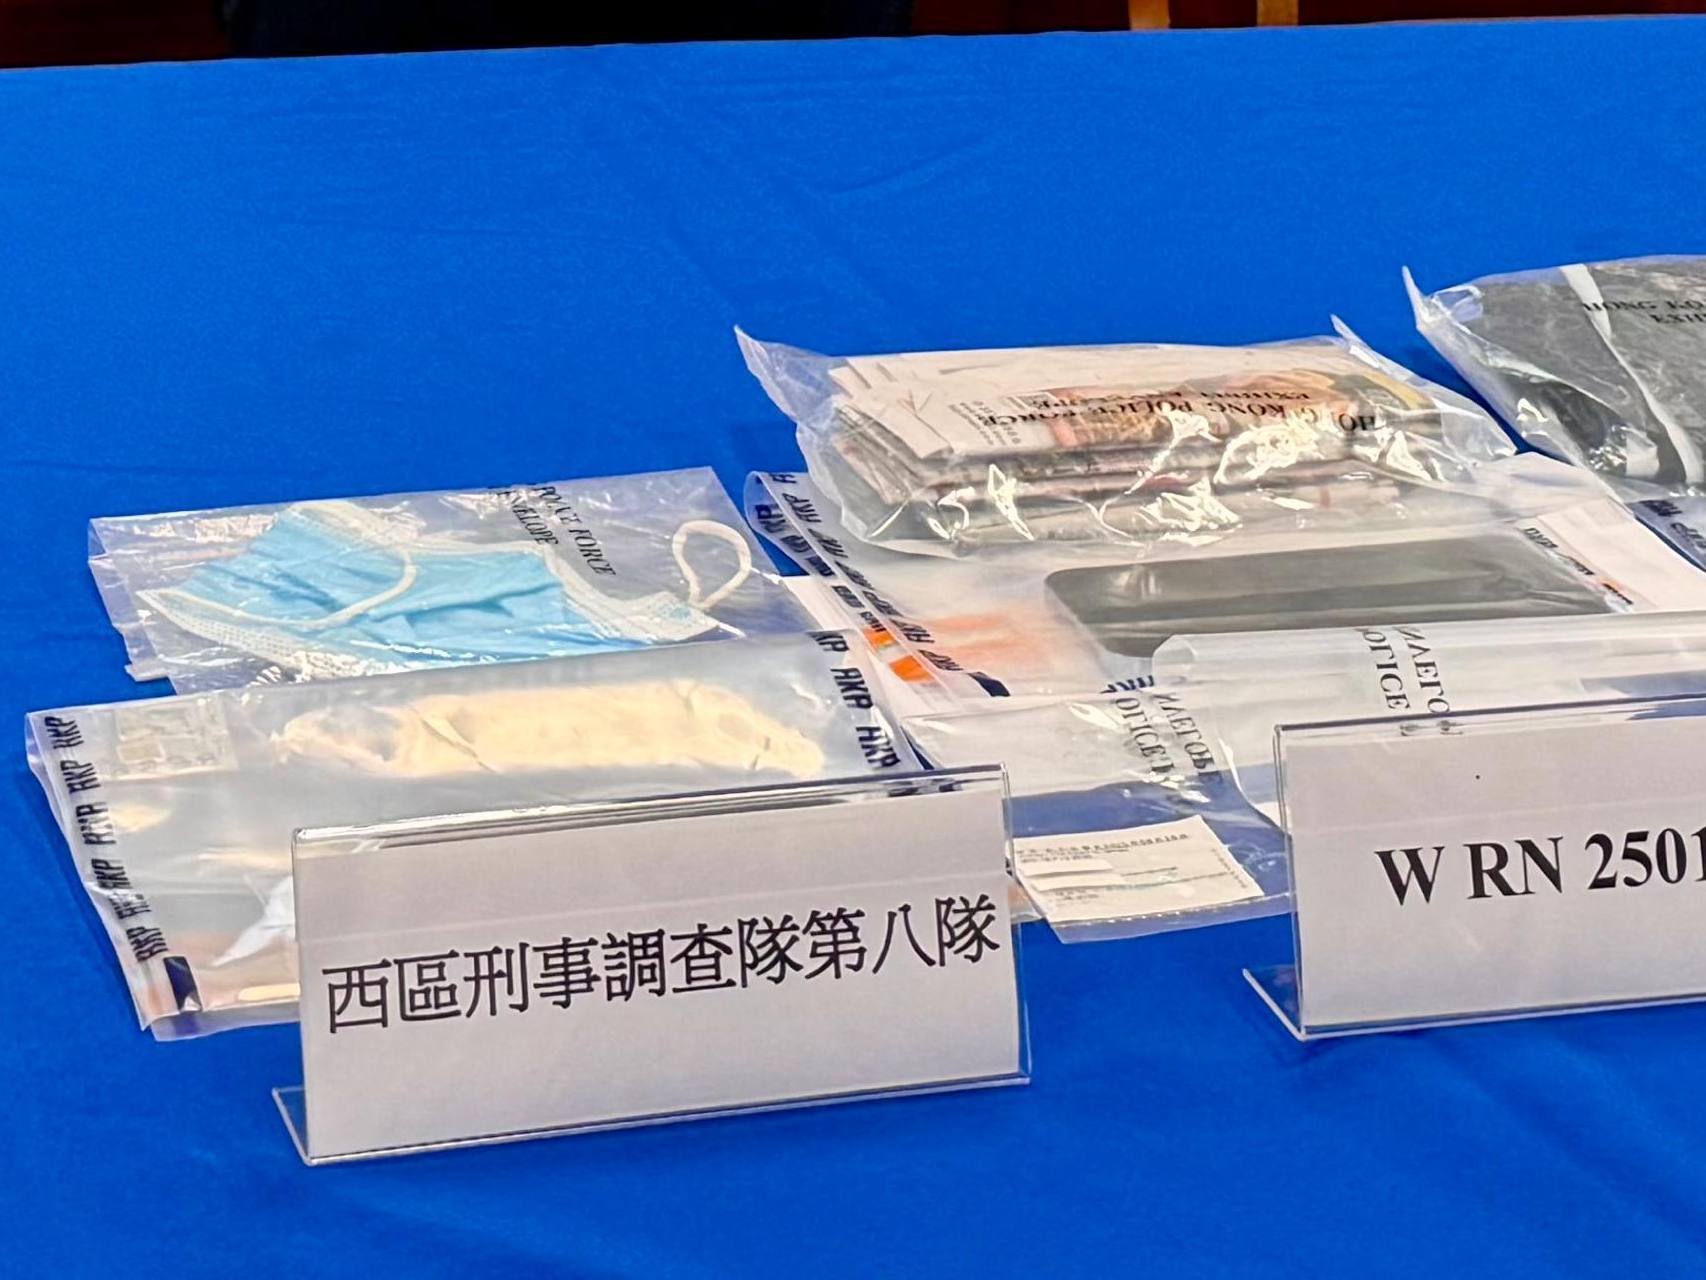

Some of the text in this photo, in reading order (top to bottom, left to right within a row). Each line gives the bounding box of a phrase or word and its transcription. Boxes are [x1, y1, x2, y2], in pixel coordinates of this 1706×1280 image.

[830, 667, 874, 710] HKP
[45, 716, 84, 750] HKP
[1375, 846, 1445, 906] W
[1464, 837, 1564, 900] RN
[321, 893, 1001, 1034] 西區刑事調查隊第八隊
